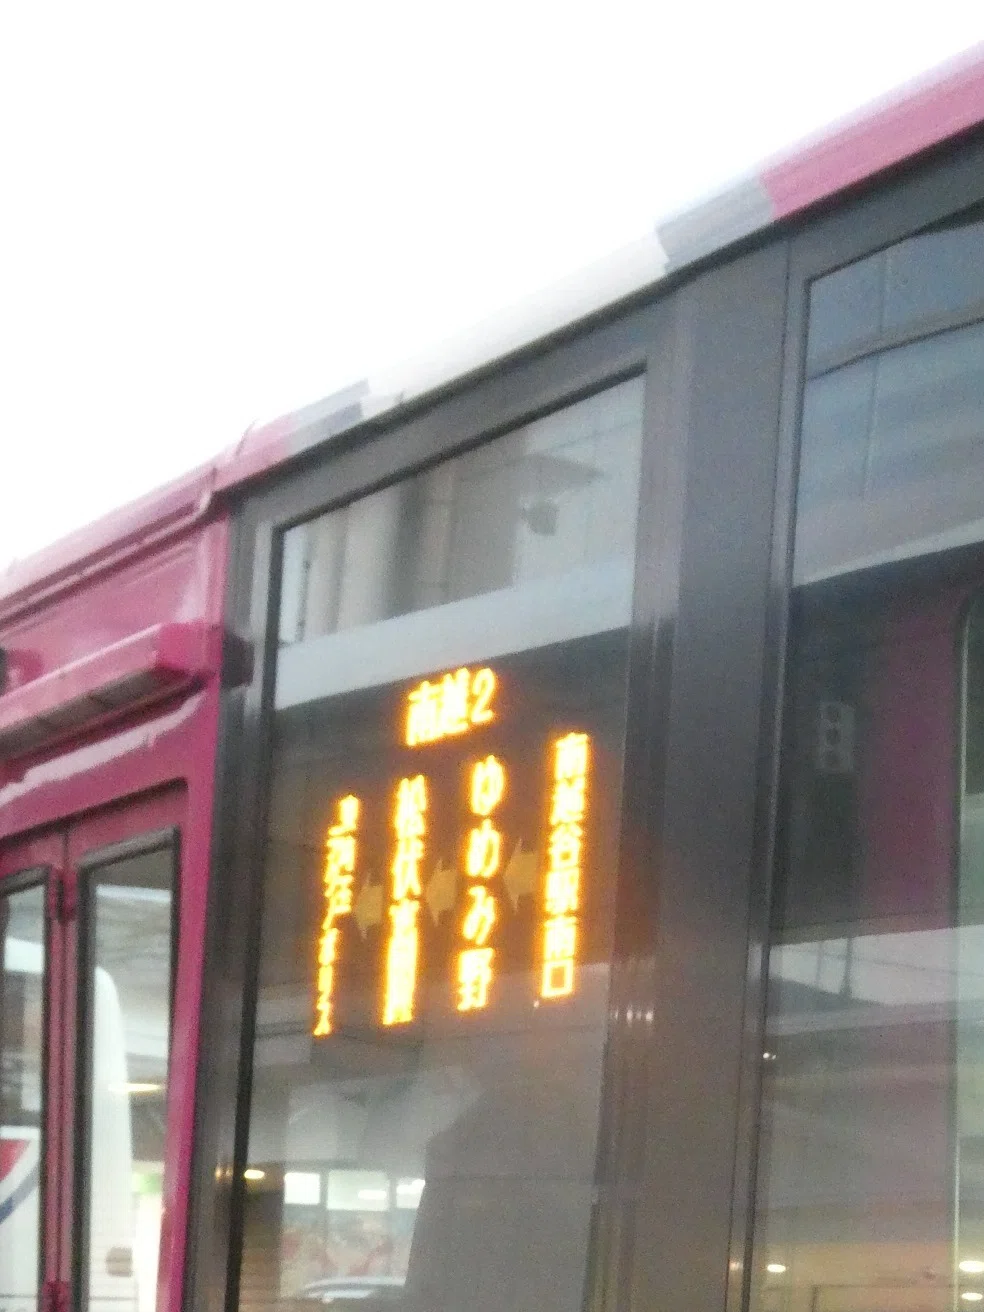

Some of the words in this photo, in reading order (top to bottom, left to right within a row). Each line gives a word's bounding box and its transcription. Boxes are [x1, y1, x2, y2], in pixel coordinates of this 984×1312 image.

[456, 754, 506, 1012] ゆめみ野
[540, 731, 590, 1000] 南越谷駅南口
